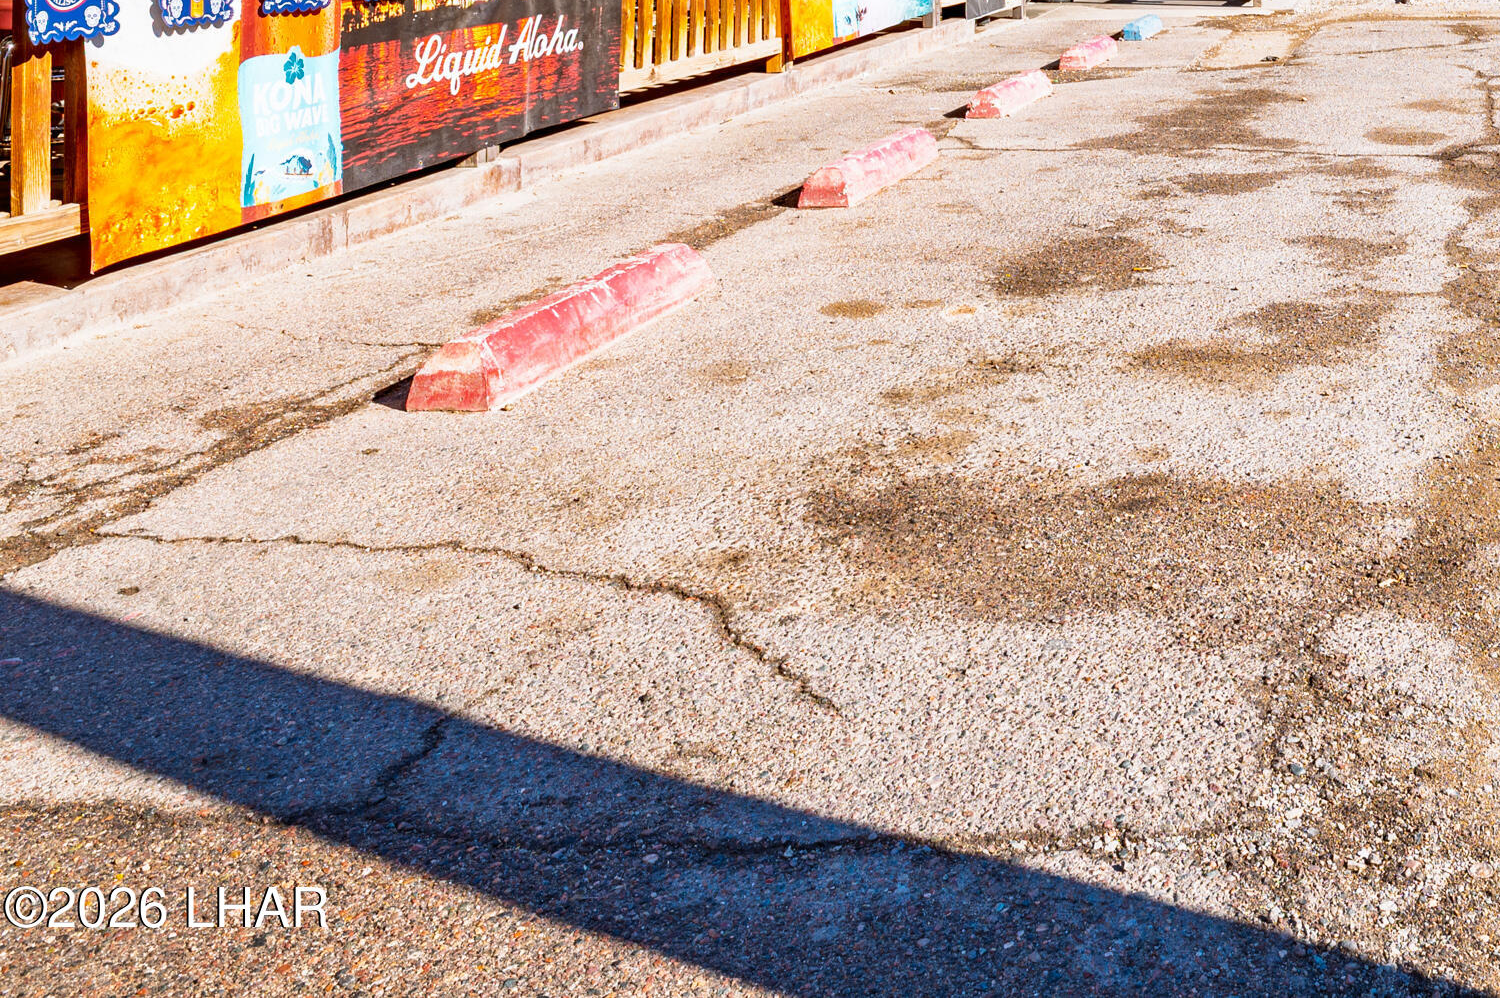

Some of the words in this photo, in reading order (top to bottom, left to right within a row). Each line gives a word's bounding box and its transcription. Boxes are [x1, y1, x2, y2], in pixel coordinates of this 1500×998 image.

[405, 24, 509, 95] Liquid
[253, 72, 326, 115] KONA
[255, 113, 281, 138] BIG
[281, 104, 330, 131] WAVE
